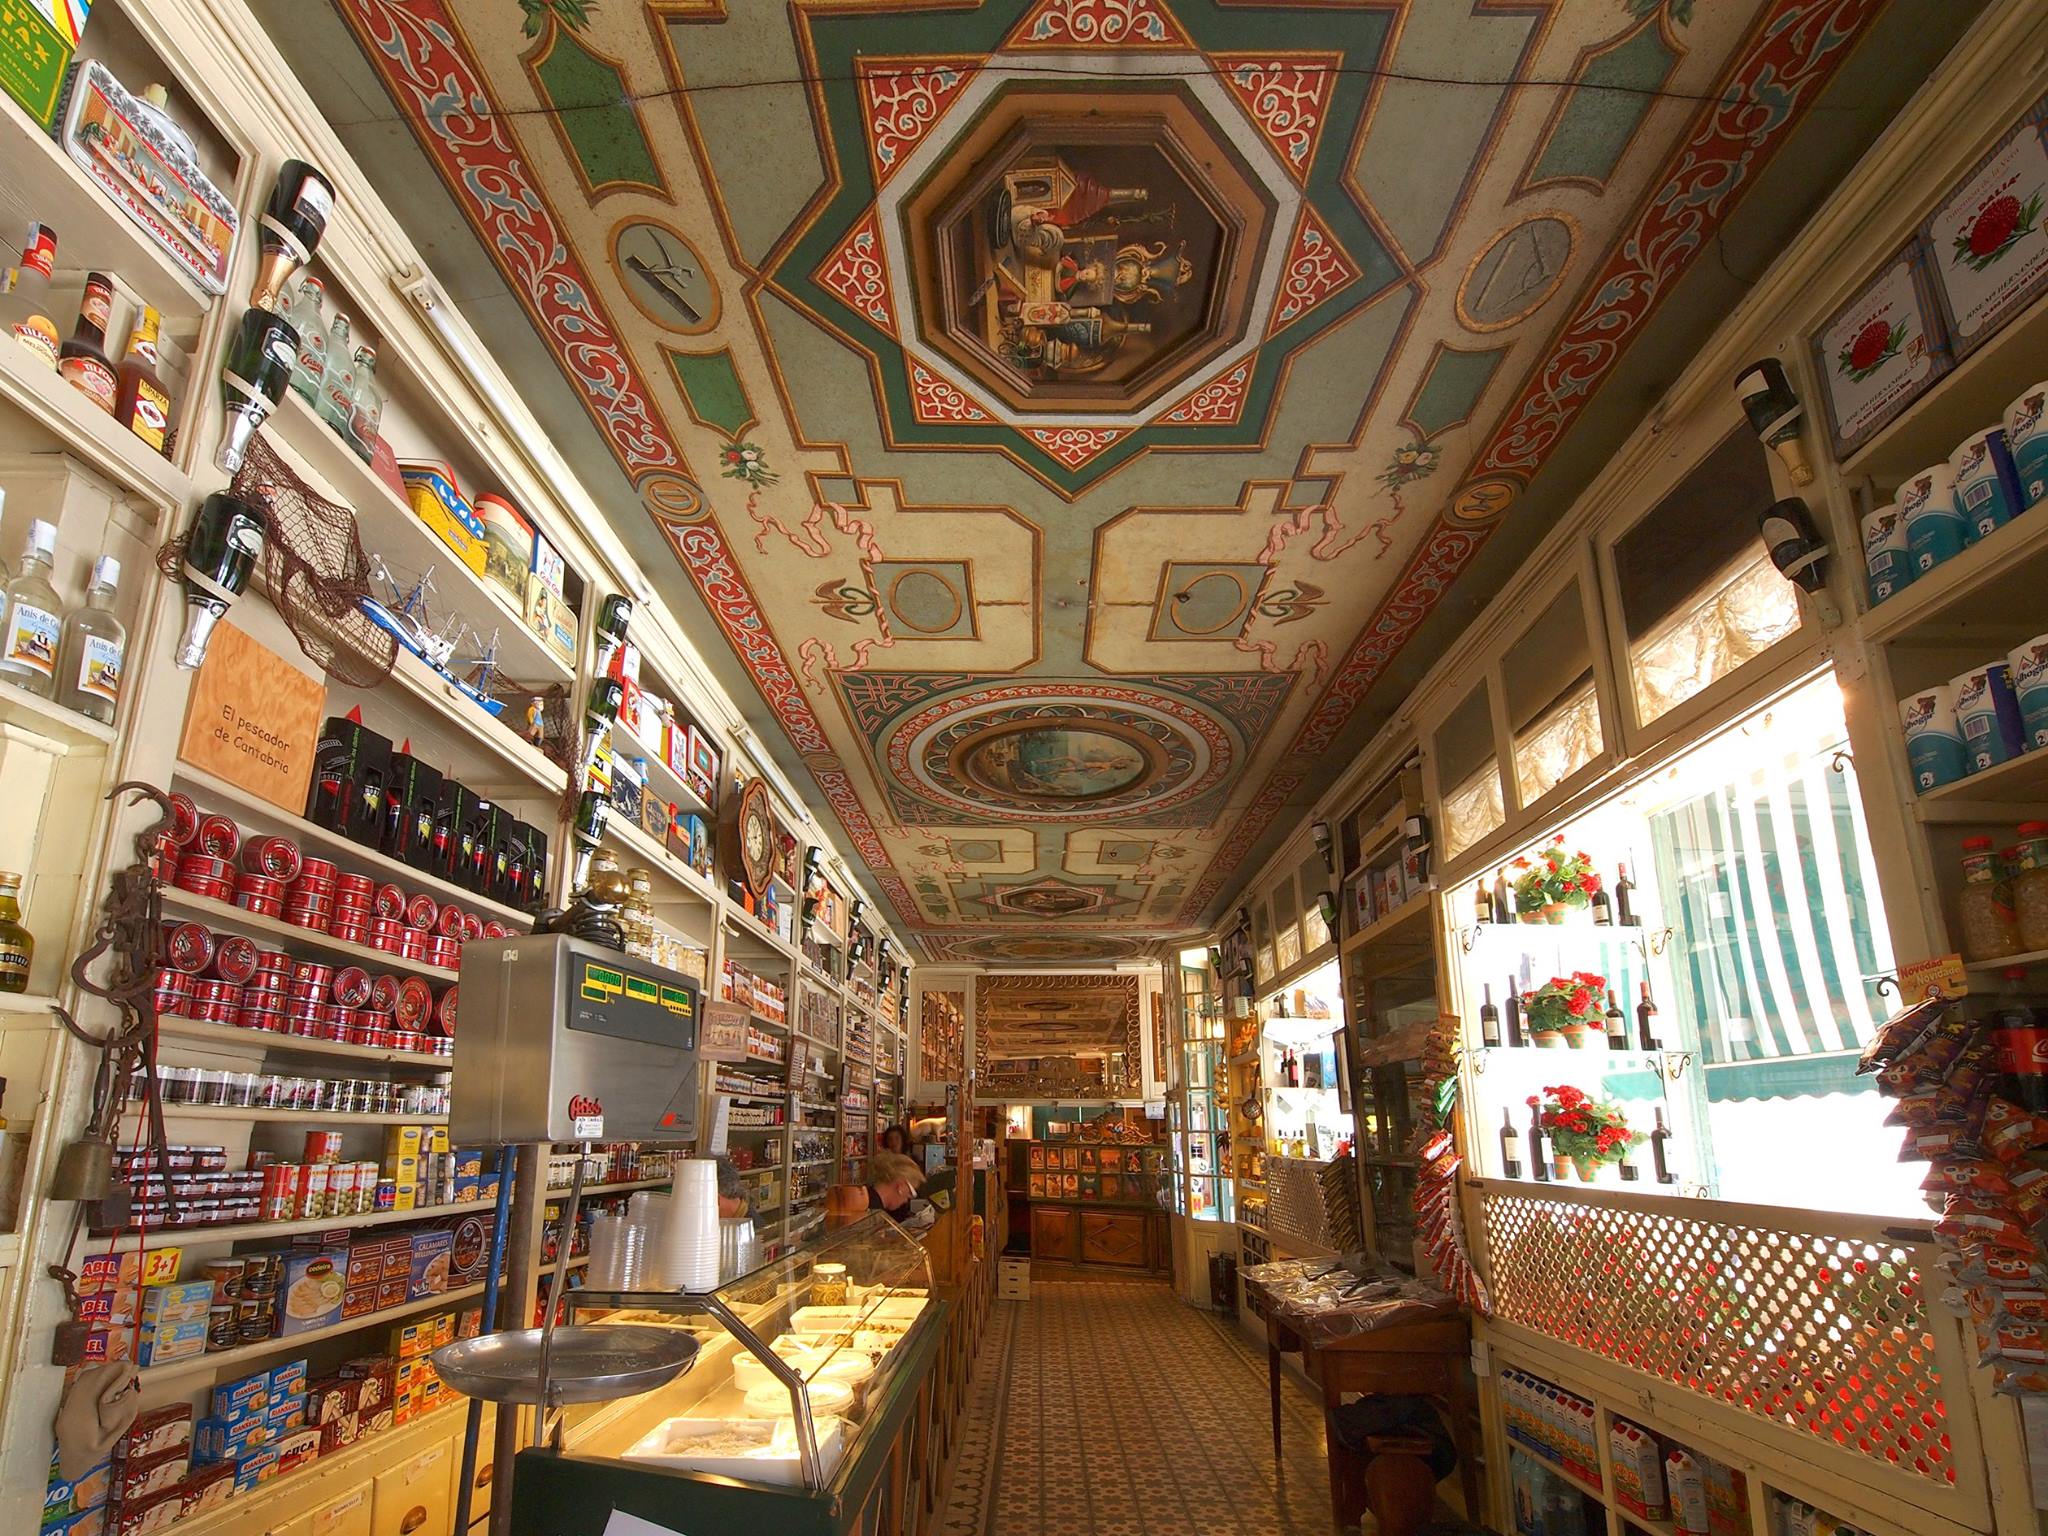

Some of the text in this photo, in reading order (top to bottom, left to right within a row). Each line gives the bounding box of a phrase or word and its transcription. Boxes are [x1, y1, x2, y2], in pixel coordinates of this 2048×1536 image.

[22, 326, 58, 357] TILFORD
[84, 362, 117, 391] TILFORD
[2032, 486, 2040, 497] 2
[1981, 524, 1989, 534] 2
[1921, 559, 1928, 568] 2
[1879, 587, 1886, 596] 2
[17, 605, 38, 620] Anis
[40, 612, 49, 624] de
[89, 638, 108, 652] Anis
[223, 704, 235, 721] El
[237, 717, 290, 751] pescador
[2037, 735, 2045, 745] 2
[214, 726, 230, 743] de
[233, 736, 289, 774] Cantabria
[1979, 758, 1986, 768] 2
[1922, 777, 1930, 786] 2
[1901, 959, 1943, 979] Novedad
[147, 1253, 180, 1277] 3+1
[285, 1440, 315, 1458] CUCA
